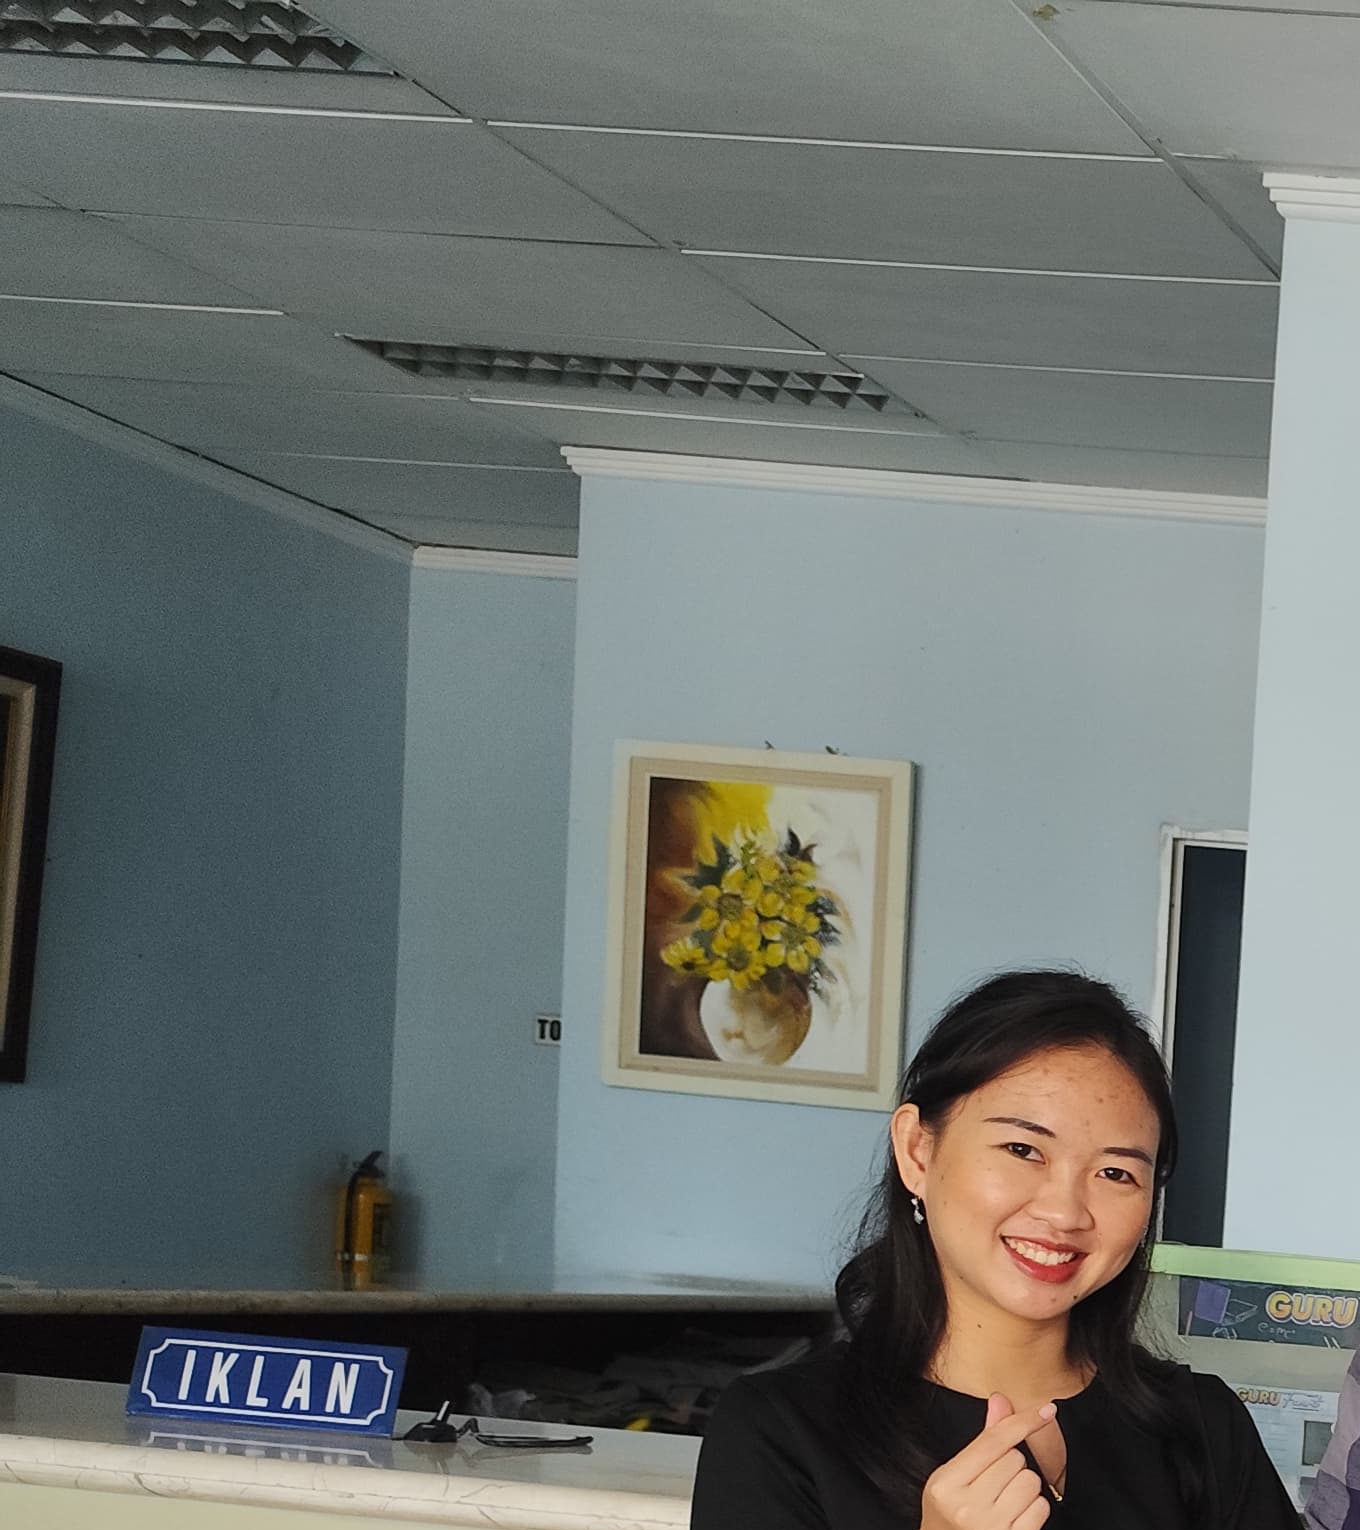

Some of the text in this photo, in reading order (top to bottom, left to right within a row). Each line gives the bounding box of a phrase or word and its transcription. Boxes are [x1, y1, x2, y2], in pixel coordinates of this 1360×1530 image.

[1266, 1291, 1358, 1328] GURU
[178, 1350, 359, 1413] IKLAN
[1237, 1388, 1280, 1406] GURU
